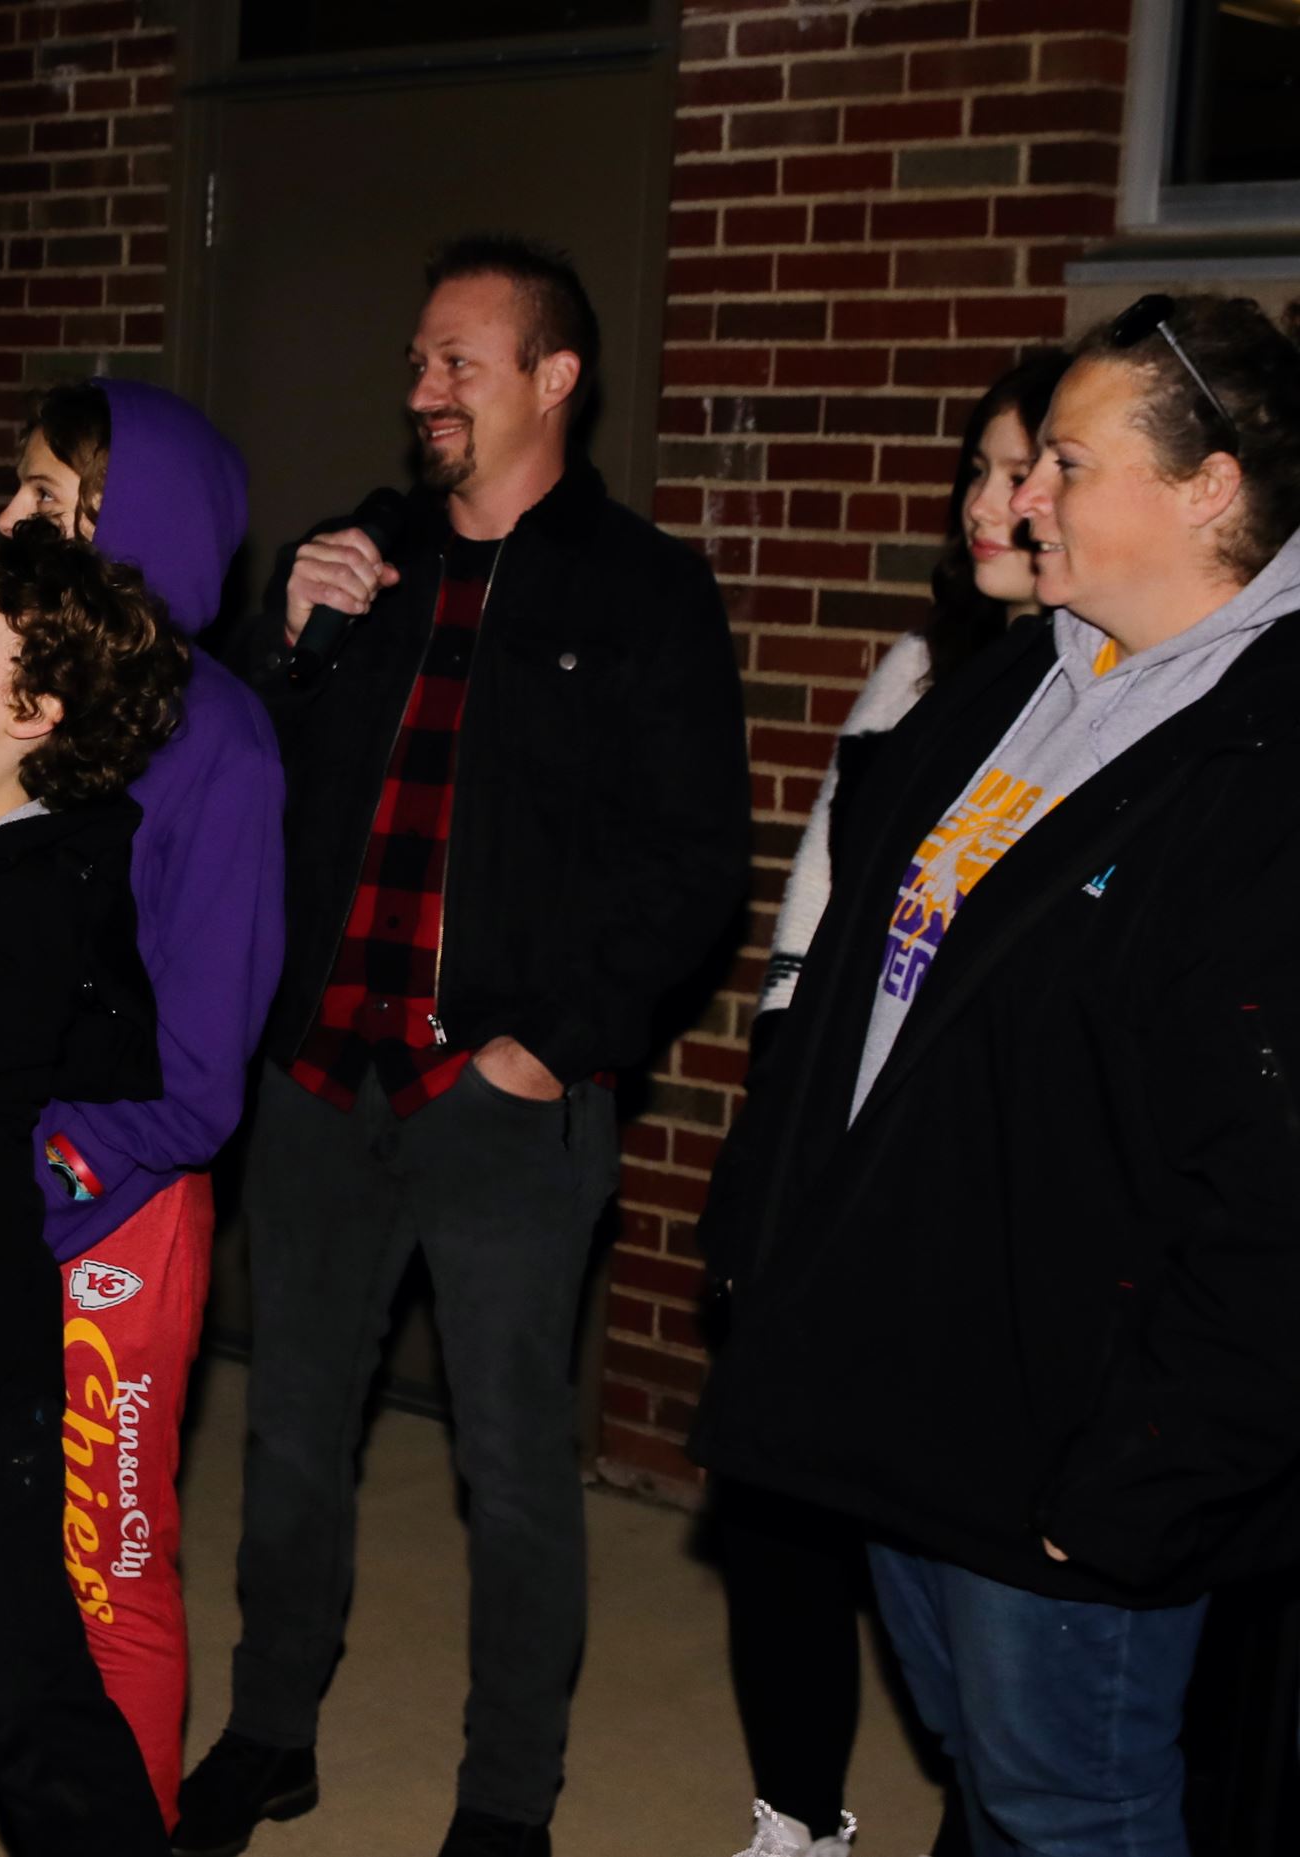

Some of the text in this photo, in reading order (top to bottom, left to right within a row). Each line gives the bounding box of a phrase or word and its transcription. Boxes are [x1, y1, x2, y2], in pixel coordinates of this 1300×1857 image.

[86, 1272, 126, 1299] KC
[61, 1317, 120, 1625] Chiefs
[110, 1373, 152, 1578] Kansas City
